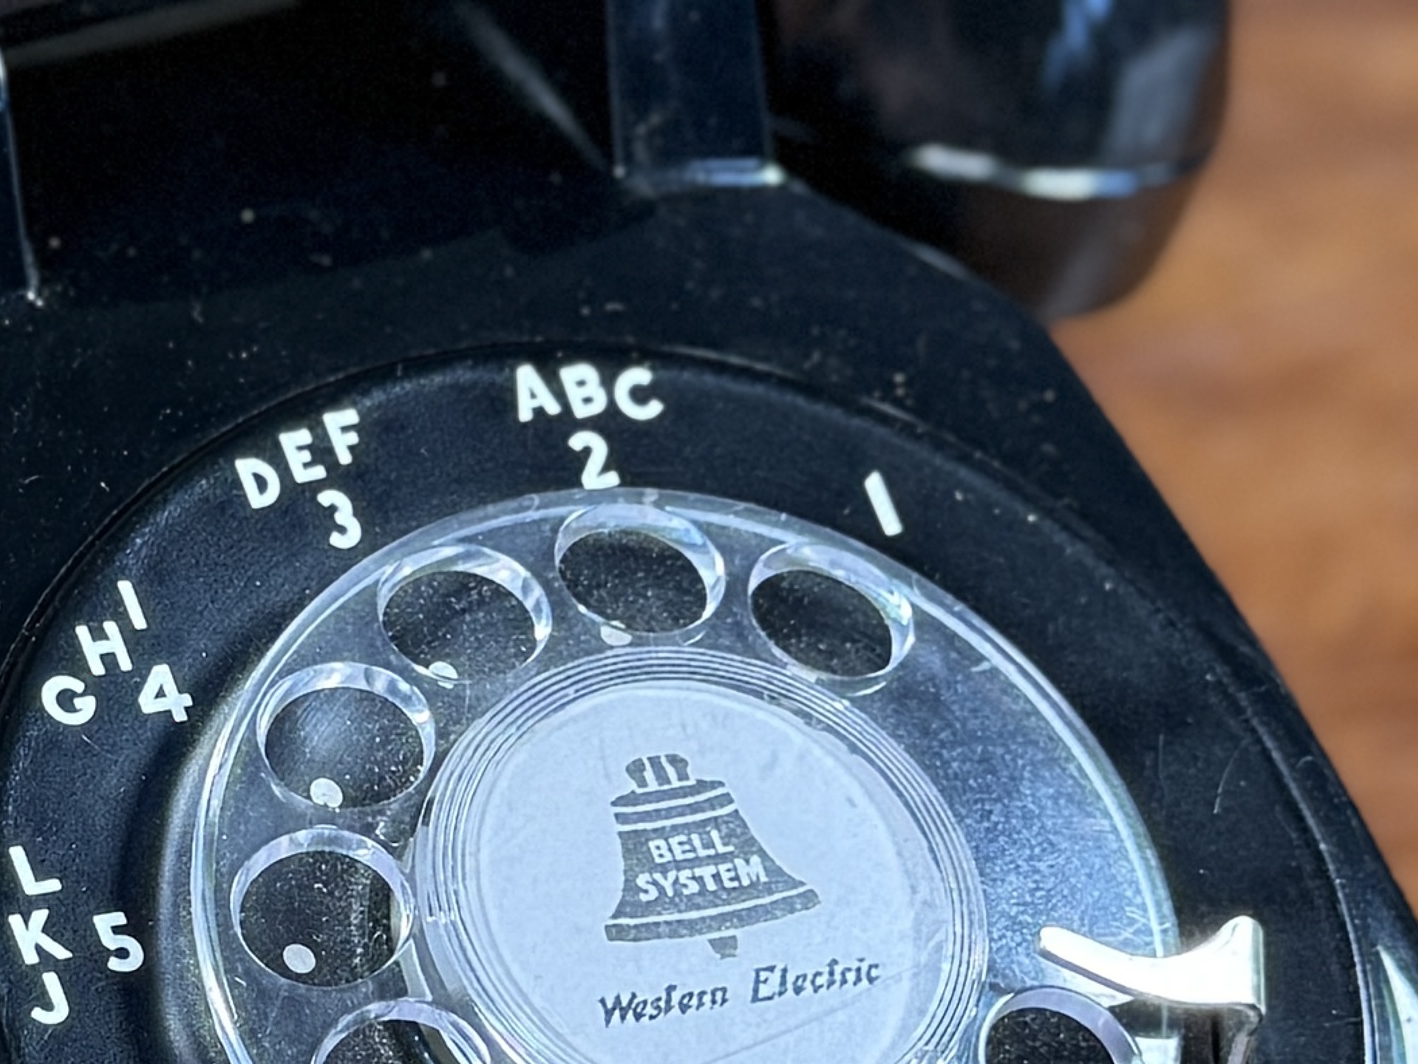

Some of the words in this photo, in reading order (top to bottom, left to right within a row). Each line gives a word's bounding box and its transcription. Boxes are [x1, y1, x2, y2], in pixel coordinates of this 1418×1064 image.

[515, 362, 665, 423] ABC
[234, 407, 361, 510] DEF
[567, 430, 621, 491] 2
[316, 488, 362, 550] 3
[863, 470, 903, 537] 1
[40, 579, 148, 726] GHI
[137, 662, 193, 723] 4
[647, 829, 735, 864] BELL
[635, 855, 768, 902] SYSTEM
[92, 911, 145, 973] 5
[598, 983, 729, 1029] Western
[749, 957, 881, 1004] Electric
